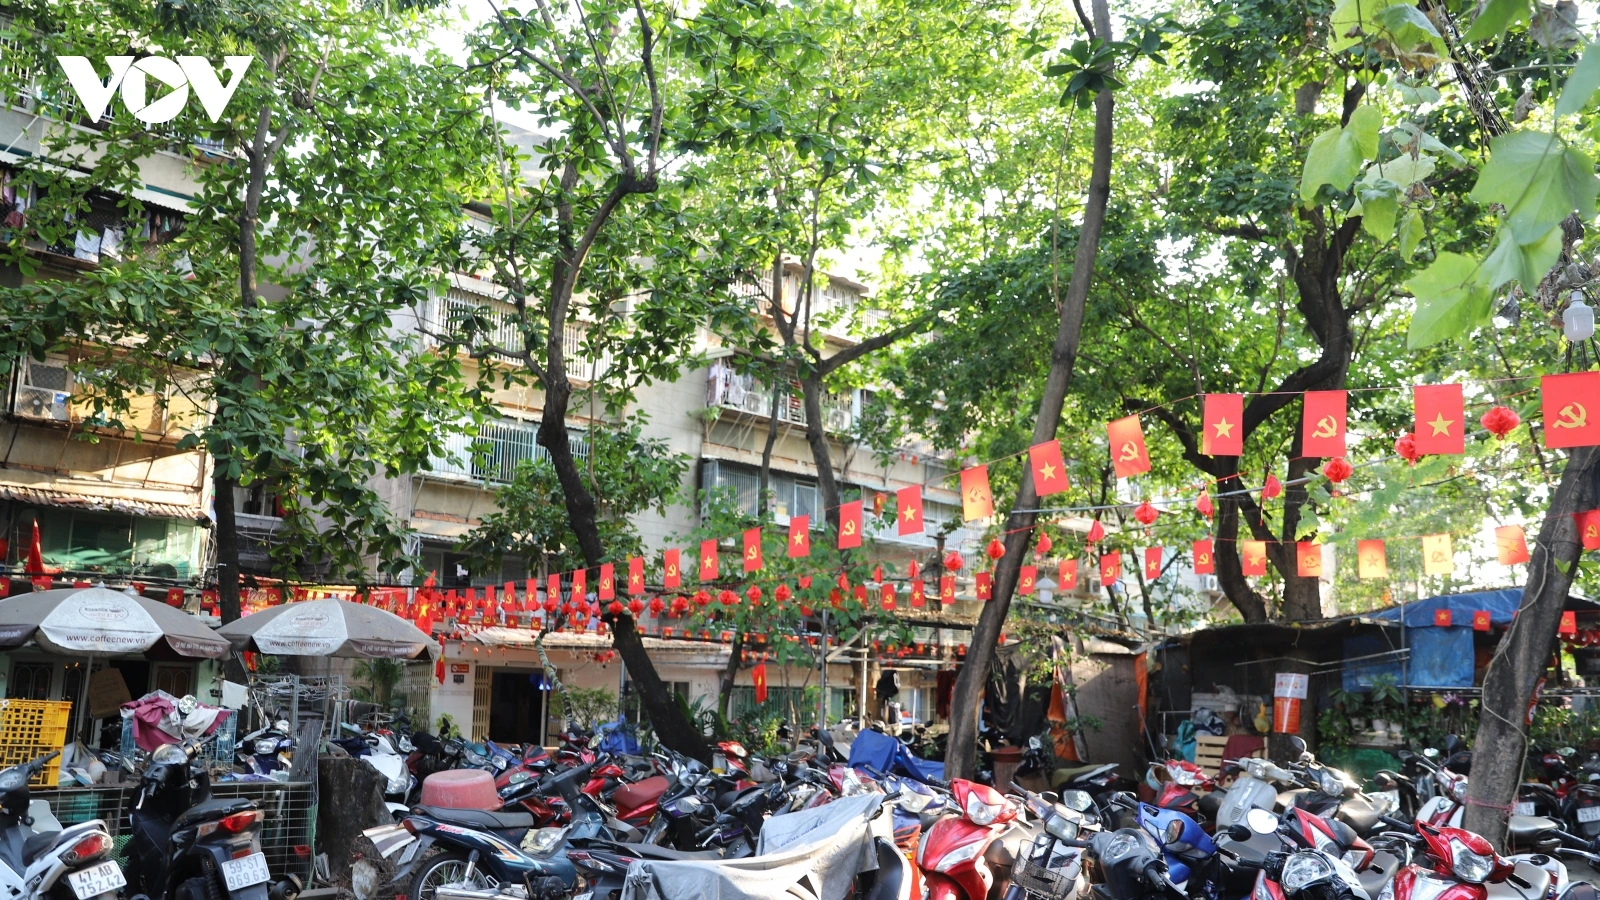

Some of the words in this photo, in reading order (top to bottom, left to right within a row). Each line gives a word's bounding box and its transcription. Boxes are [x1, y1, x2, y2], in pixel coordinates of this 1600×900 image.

[66, 633, 146, 644] www.coffeenew.vn
[269, 640, 331, 649] www.coffeenew.vn
[78, 864, 113, 884] 47-AB
[228, 868, 267, 888] 969.63
[78, 874, 123, 898] 752.42
